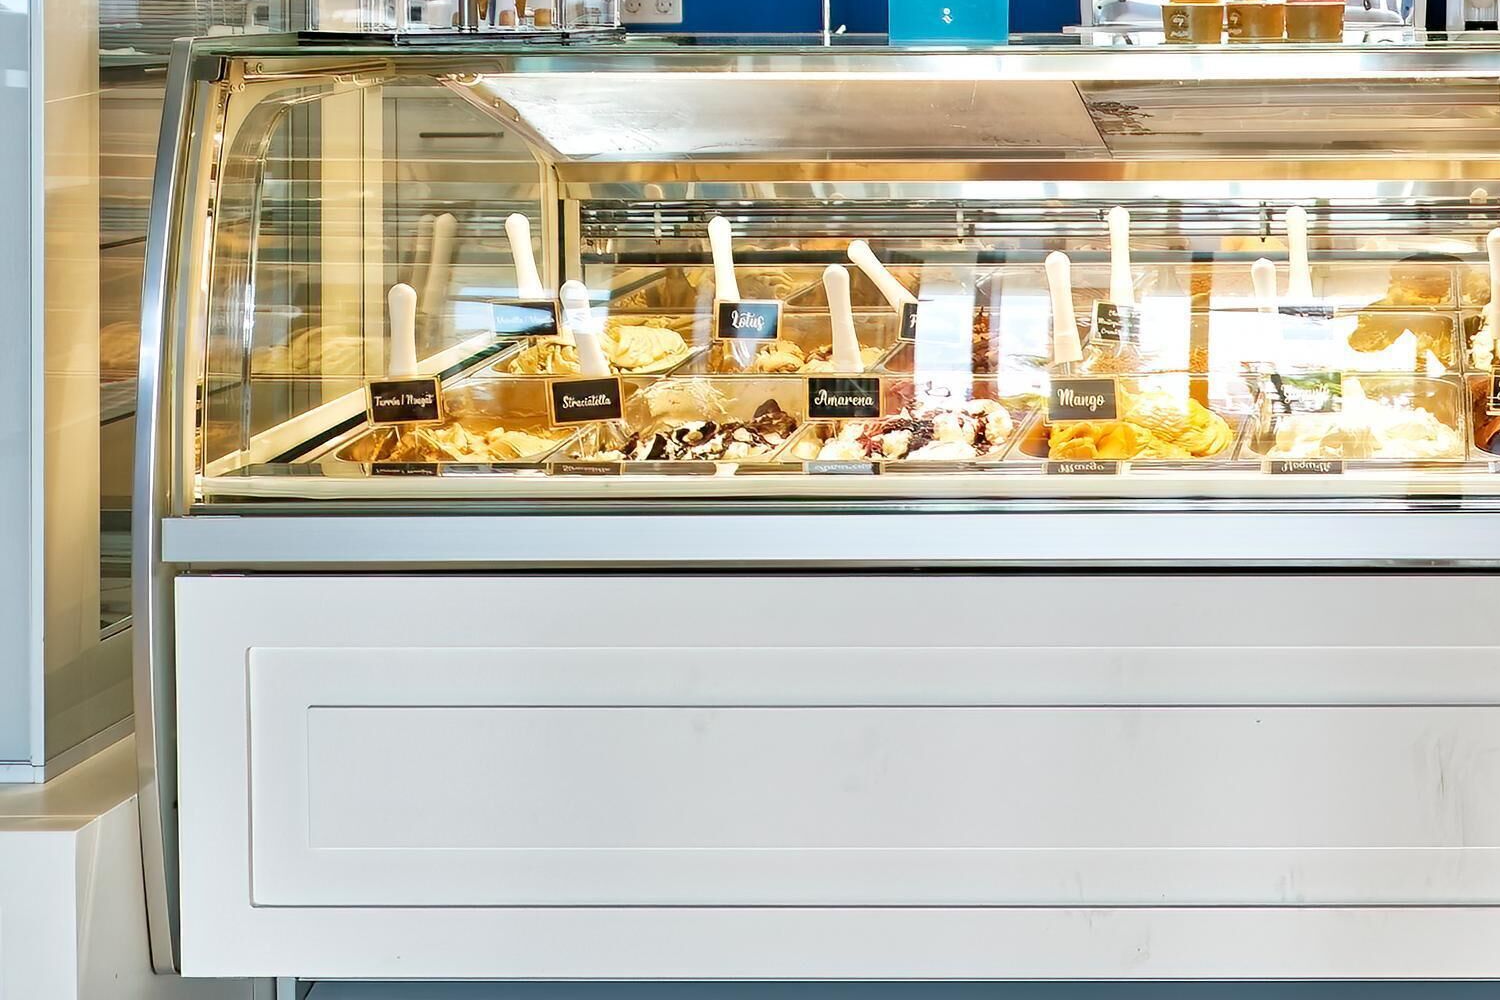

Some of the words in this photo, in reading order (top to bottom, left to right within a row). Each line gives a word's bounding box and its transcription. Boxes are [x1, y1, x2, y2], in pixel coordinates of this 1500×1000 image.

[731, 310, 765, 331] Lotus
[814, 389, 874, 407] Amarena
[1057, 389, 1105, 412] Mango
